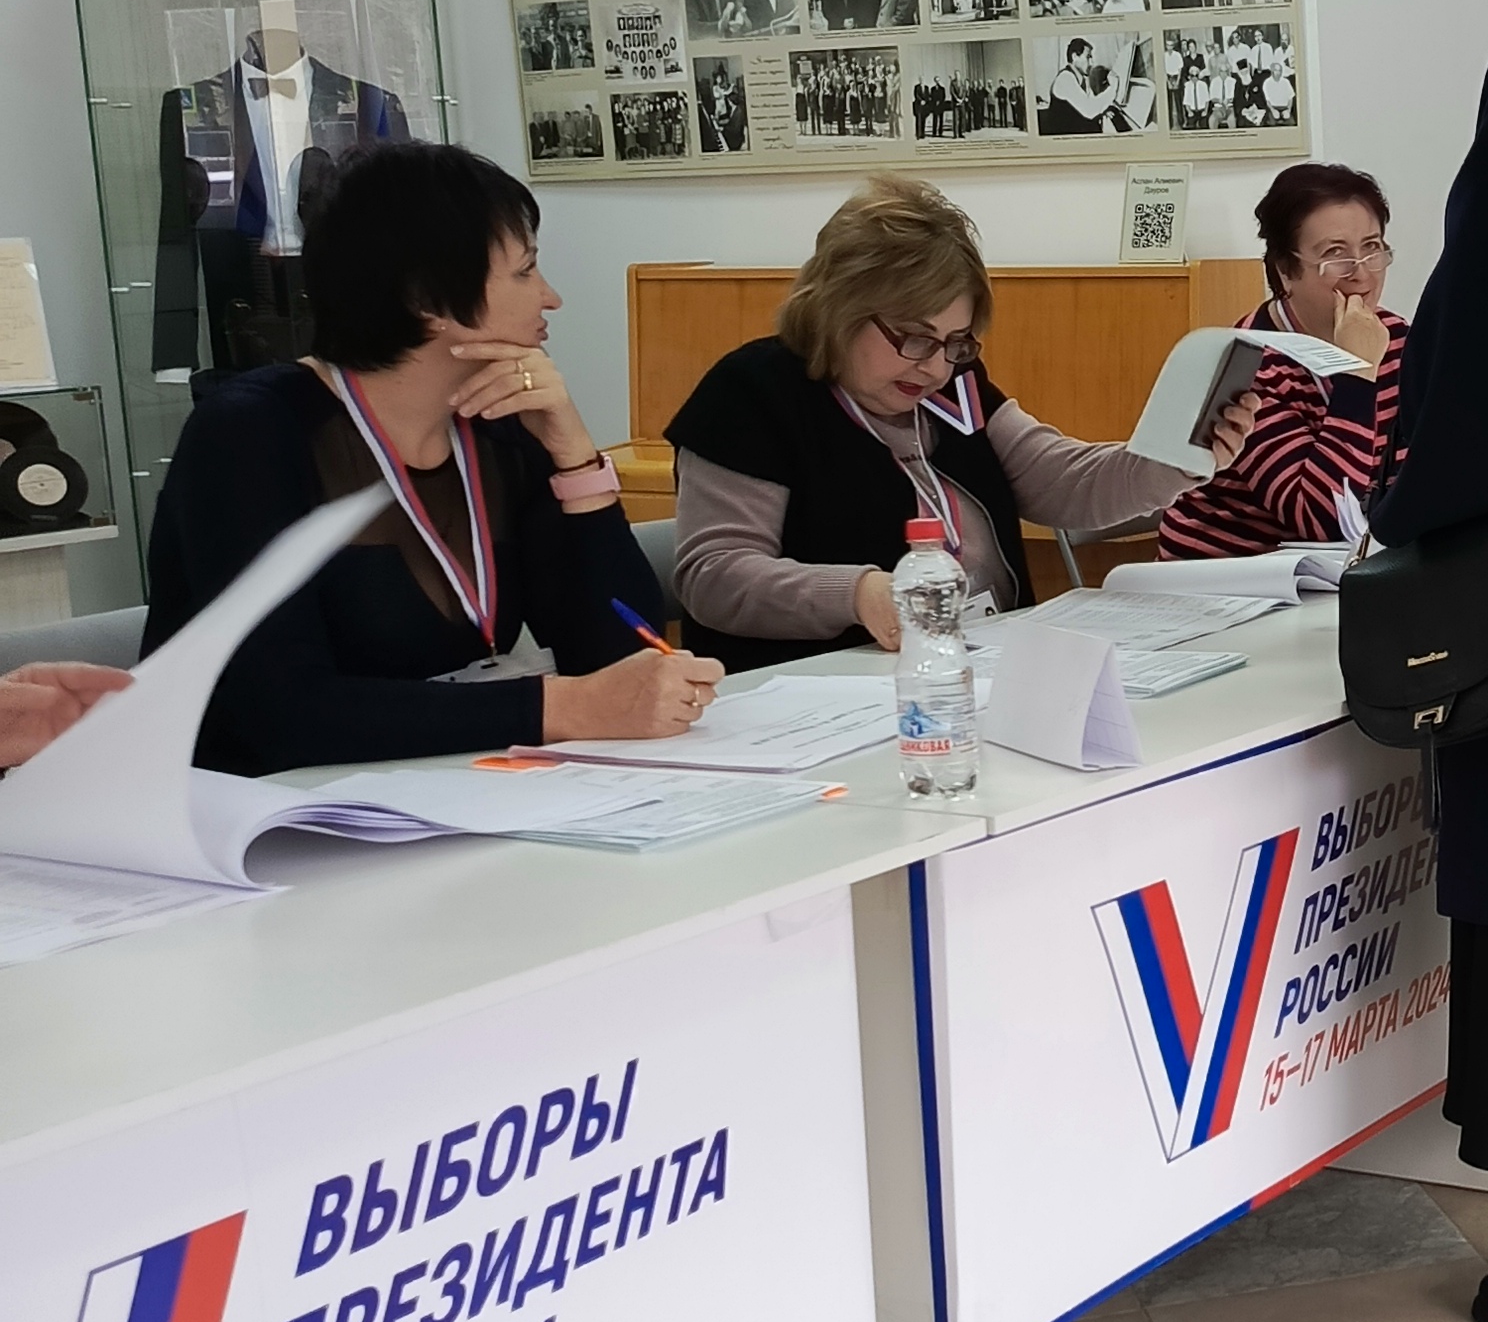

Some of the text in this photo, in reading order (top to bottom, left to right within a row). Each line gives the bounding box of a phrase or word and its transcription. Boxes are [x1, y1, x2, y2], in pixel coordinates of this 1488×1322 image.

[1274, 921, 1401, 1039] РОССИИ
[1325, 988, 1400, 1071] МАРТА
[296, 1059, 637, 1278] ВЫБОРЫ
